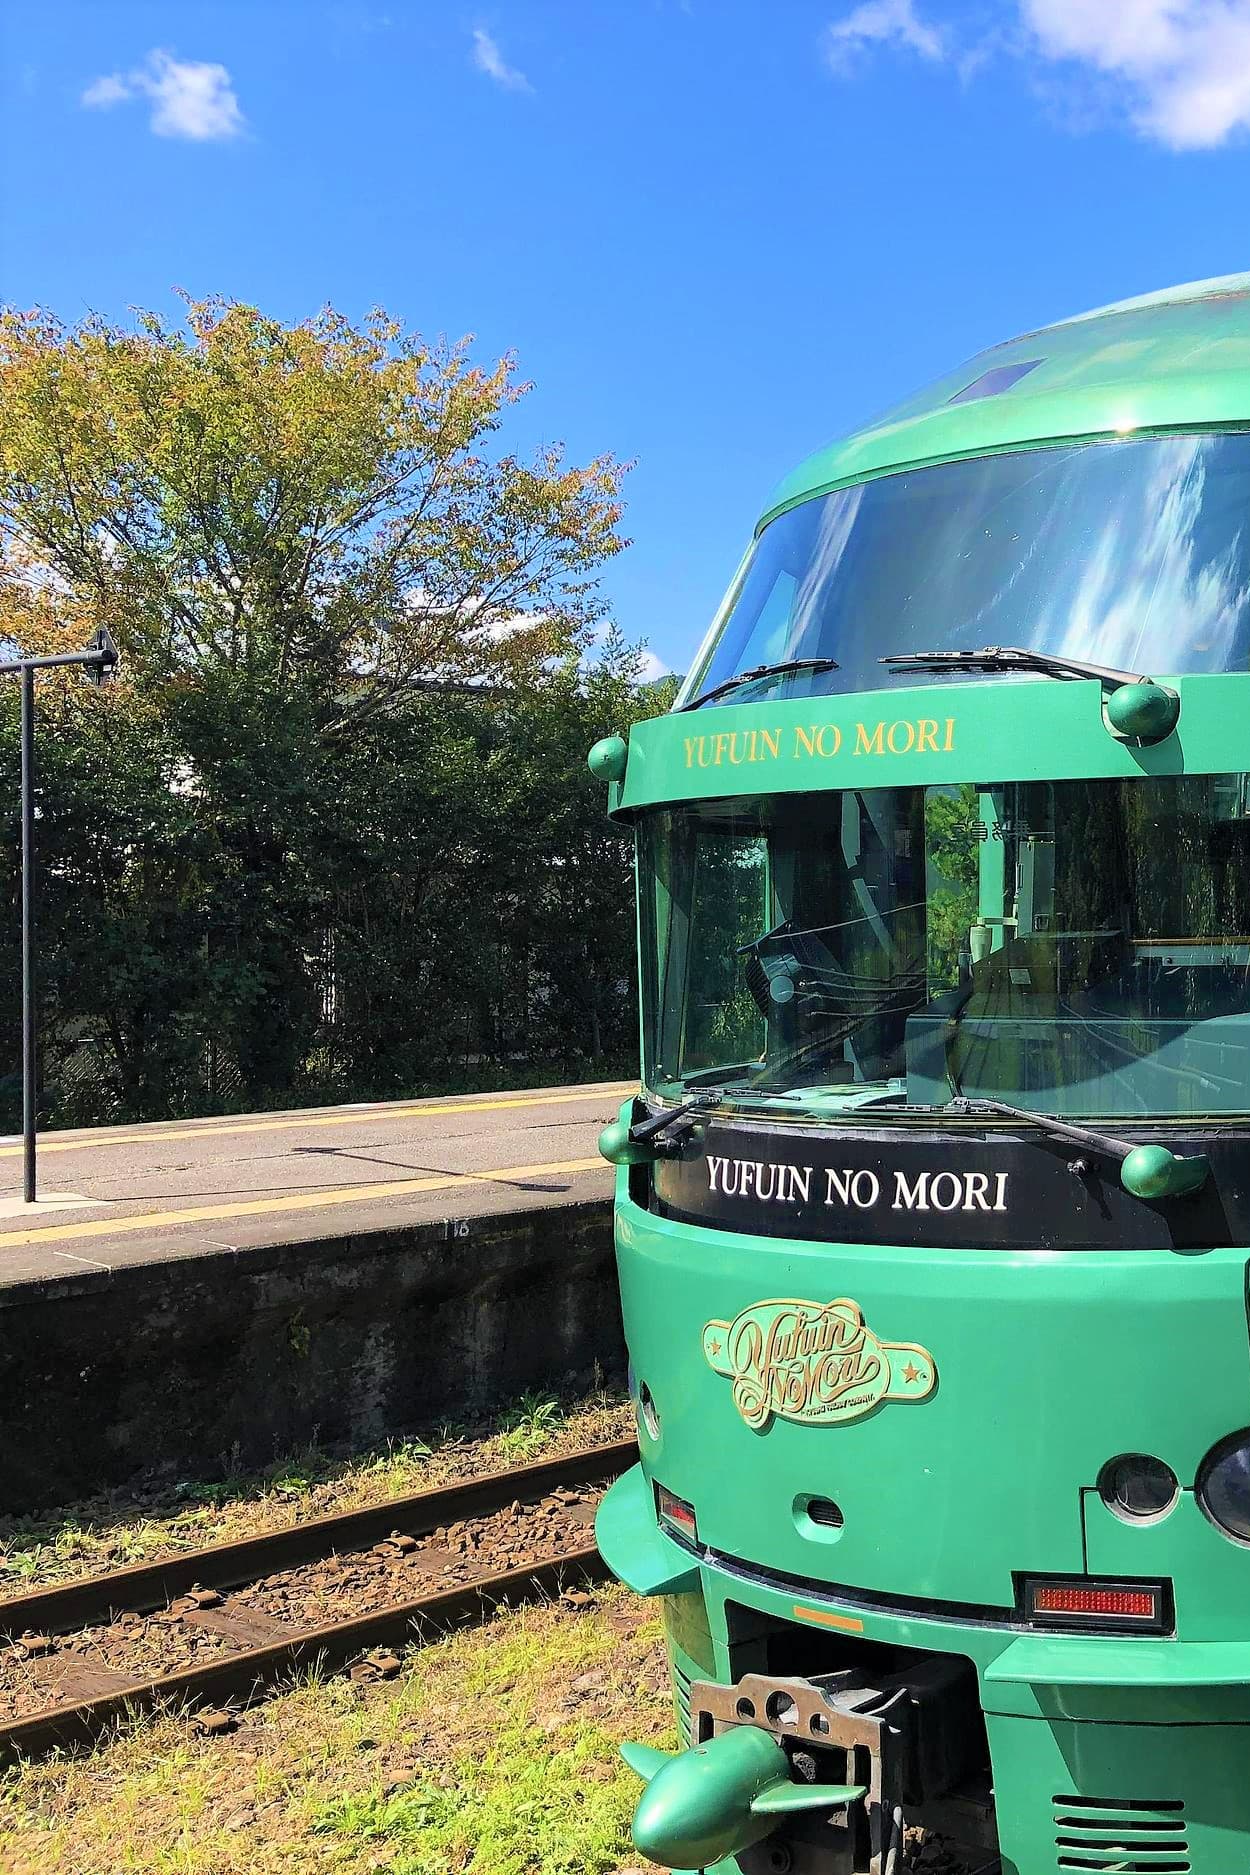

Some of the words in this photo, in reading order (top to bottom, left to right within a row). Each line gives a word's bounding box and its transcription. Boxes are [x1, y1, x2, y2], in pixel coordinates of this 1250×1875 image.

[683, 728, 783, 769] YUFUIN
[793, 724, 842, 760] NO
[853, 717, 958, 757] MORI
[705, 1154, 812, 1203] YUFUIN
[823, 1167, 880, 1209] NO
[891, 1170, 1009, 1213] MORI
